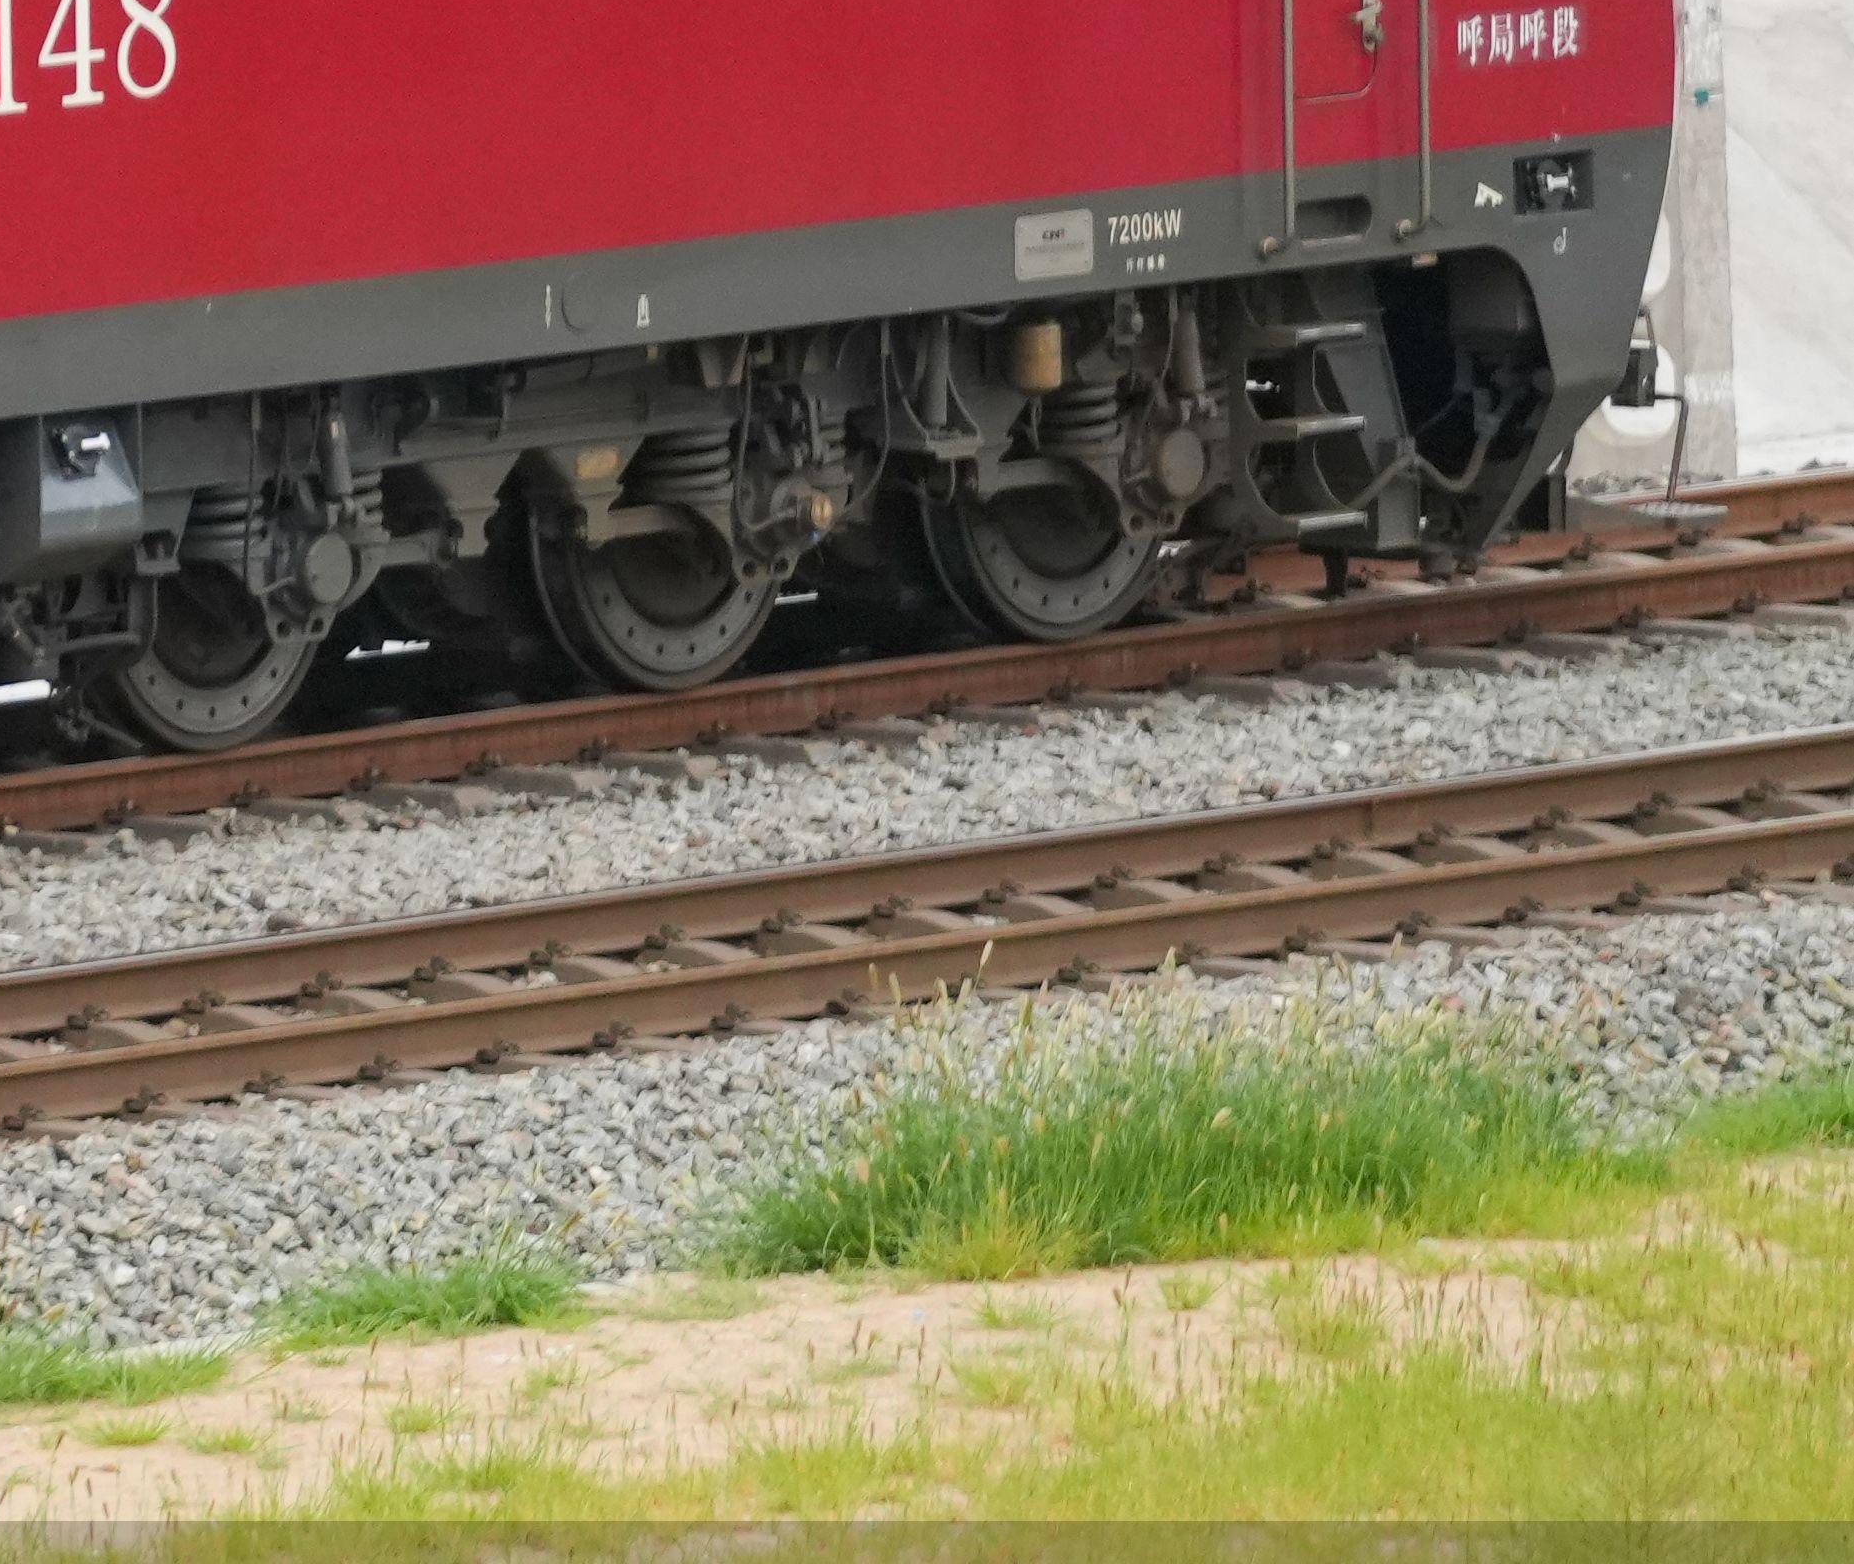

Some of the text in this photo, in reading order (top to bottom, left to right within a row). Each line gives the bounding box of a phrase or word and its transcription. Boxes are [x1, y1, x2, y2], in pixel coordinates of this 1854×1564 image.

[1457, 6, 1579, 67] 呼局呼段
[1107, 208, 1181, 246] 7200kW
